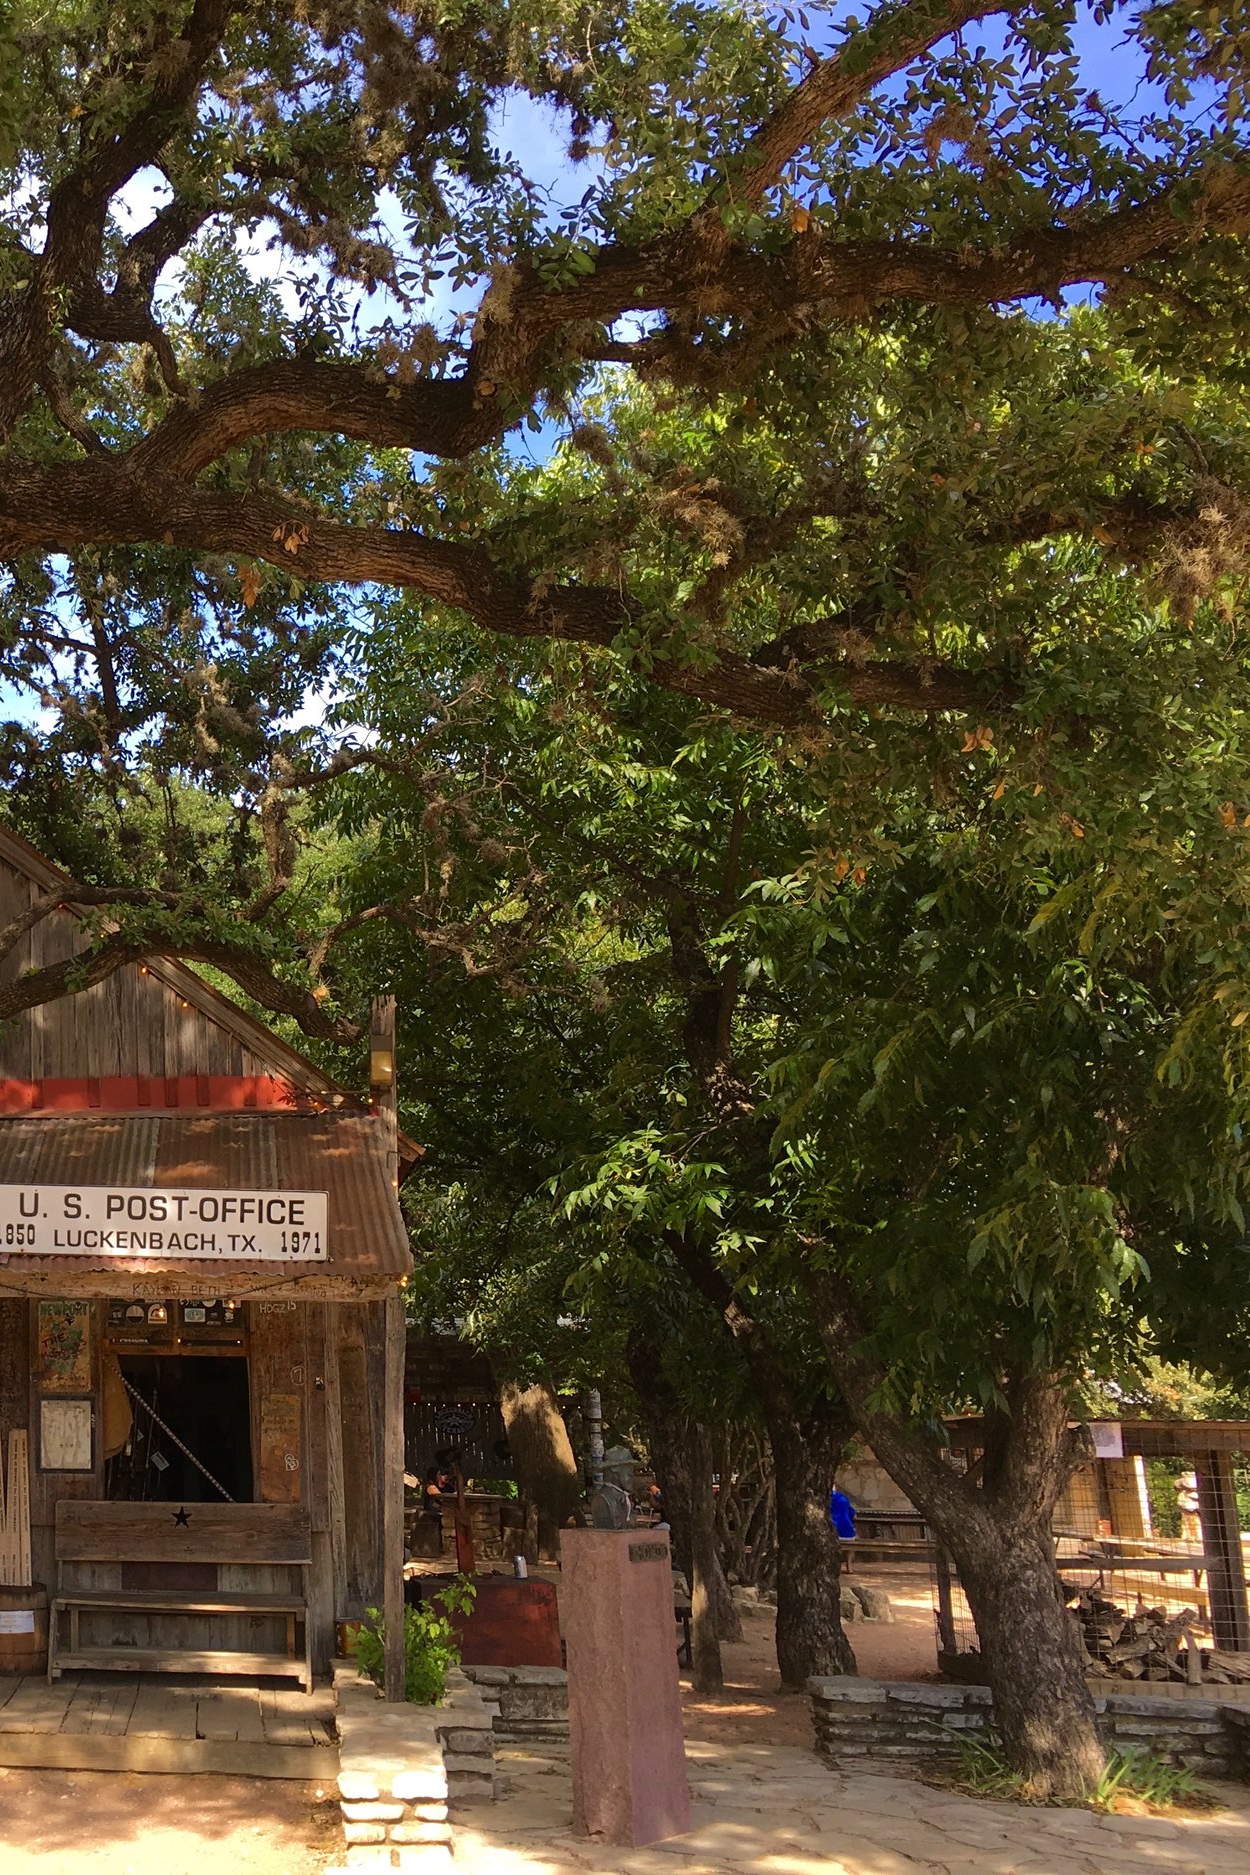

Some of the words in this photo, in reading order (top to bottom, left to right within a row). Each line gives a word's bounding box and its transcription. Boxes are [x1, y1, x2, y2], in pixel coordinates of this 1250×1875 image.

[19, 1192, 47, 1218] U.
[63, 1193, 91, 1219] S.
[106, 1194, 306, 1225] POST-OFFICE
[54, 1229, 222, 1253] LUCKENBACH,
[227, 1234, 263, 1252] TX.
[281, 1231, 321, 1254] 1971
